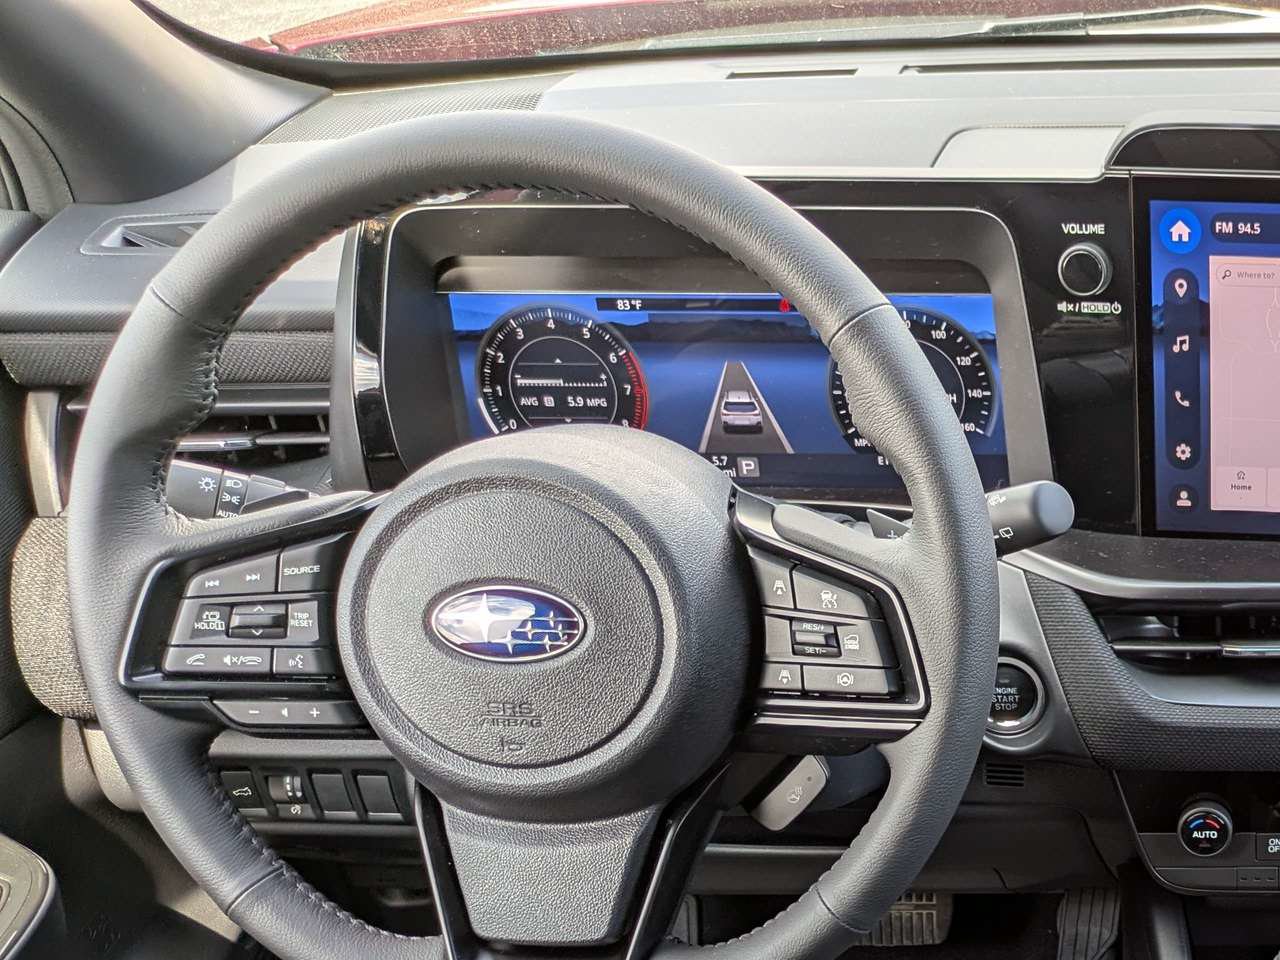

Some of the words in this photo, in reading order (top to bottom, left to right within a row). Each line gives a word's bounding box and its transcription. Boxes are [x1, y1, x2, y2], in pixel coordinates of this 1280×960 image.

[1061, 223, 1105, 235] VOLUME
[1215, 221, 1233, 234] FM
[1237, 223, 1261, 235] 94.5
[1236, 271, 1261, 280] Where
[1262, 271, 1276, 280] to?
[547, 319, 555, 329] 4
[516, 328, 524, 339] 3
[583, 328, 590, 339] 5
[931, 330, 946, 339] 100
[497, 353, 505, 364] 2
[609, 352, 617, 363] 6
[956, 356, 972, 366] 120
[496, 386, 502, 397] 1
[624, 385, 631, 396] 7
[967, 388, 983, 398] 140
[520, 397, 539, 406] AVG
[567, 396, 584, 407] 5.9
[586, 398, 607, 407] MPG
[509, 419, 517, 430] 0
[712, 455, 728, 466] 5.7
[742, 460, 755, 475] P
[1230, 483, 1252, 491] Home
[283, 565, 321, 576] SOURCE
[293, 612, 309, 620] TRIP
[290, 619, 313, 628] RESET
[992, 695, 1020, 703] START
[486, 702, 535, 716] SRS
[995, 703, 1018, 711] STOP
[481, 717, 543, 728] AIRBAG
[1192, 830, 1218, 839] AUTO
